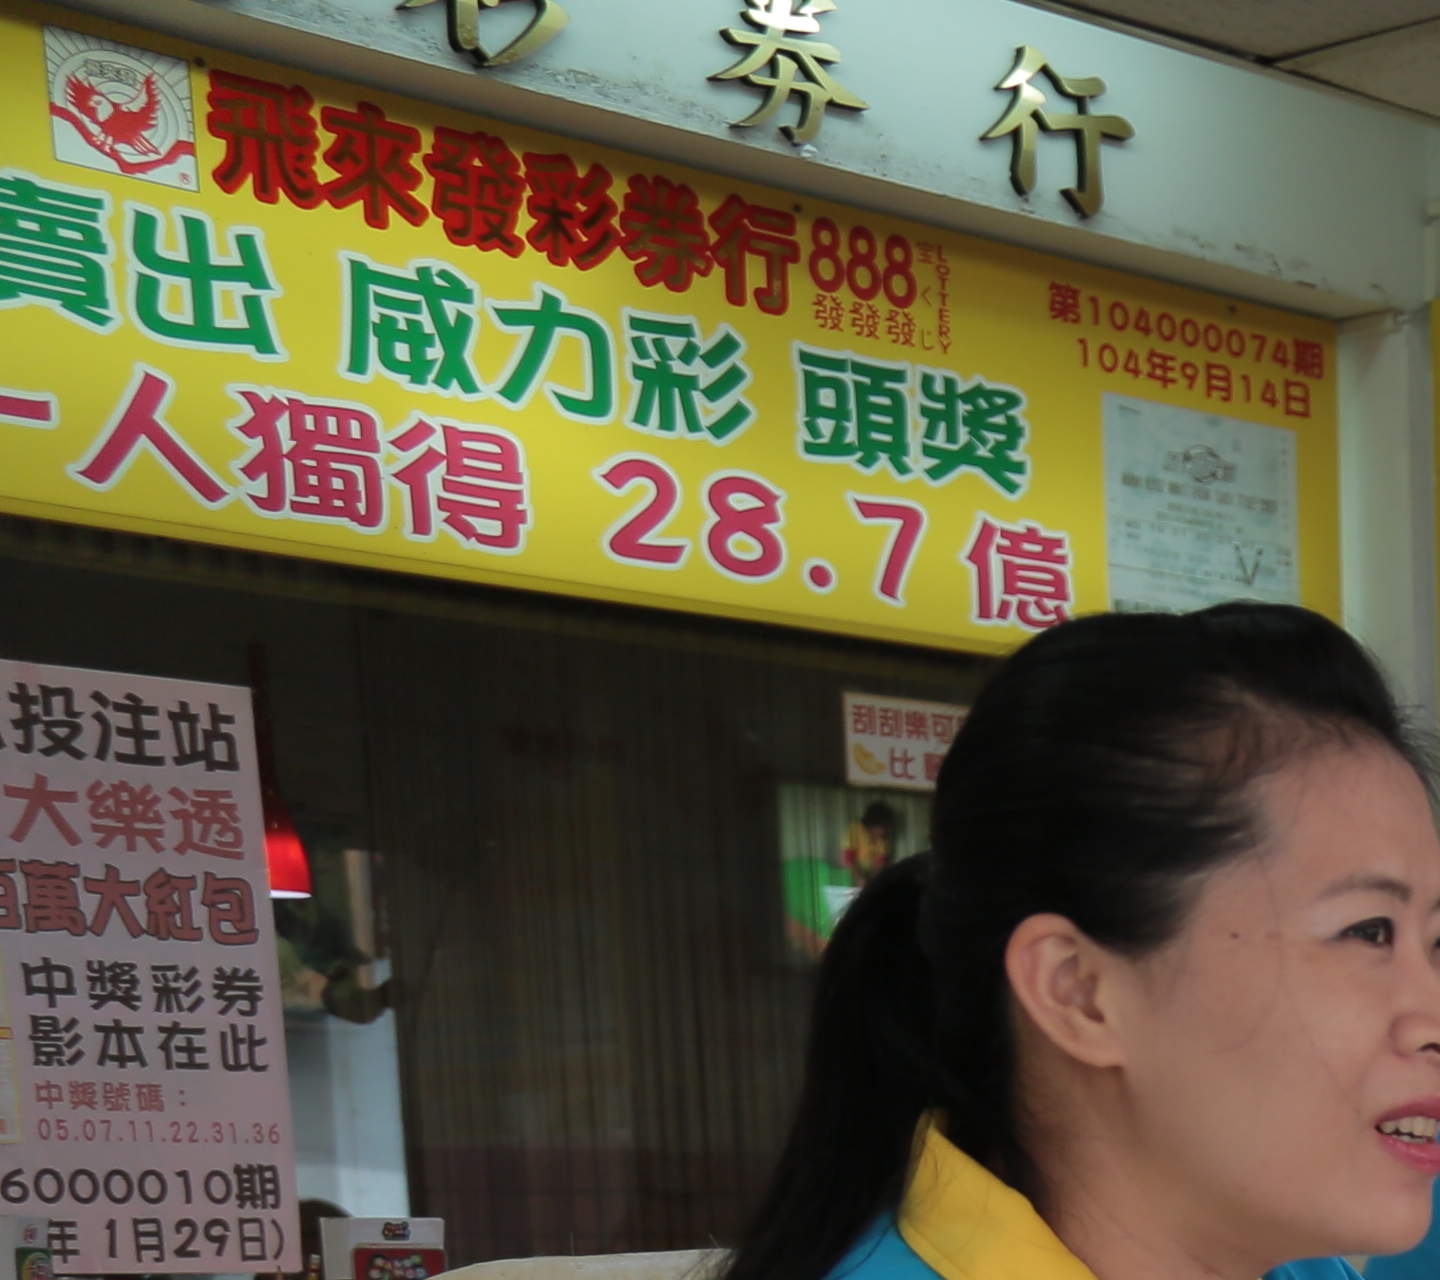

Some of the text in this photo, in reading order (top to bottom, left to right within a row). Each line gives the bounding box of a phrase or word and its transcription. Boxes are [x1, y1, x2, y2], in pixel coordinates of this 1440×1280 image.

[207, 69, 918, 314] 飛來發彩券行 888
[812, 294, 915, 347] 發發發
[1047, 281, 1323, 380] 第104000074期
[348, 261, 750, 440] 威力彩
[800, 348, 1028, 494] 頭獎
[1076, 337, 1313, 420] 104年9月14日
[0, 683, 240, 772] 投注站
[4, 773, 245, 860] 大樂透
[20, 957, 263, 1017] 中獎彩券
[28, 1013, 269, 1073] 影本在此
[38, 1118, 281, 1146] 05.07.11.22.31.36
